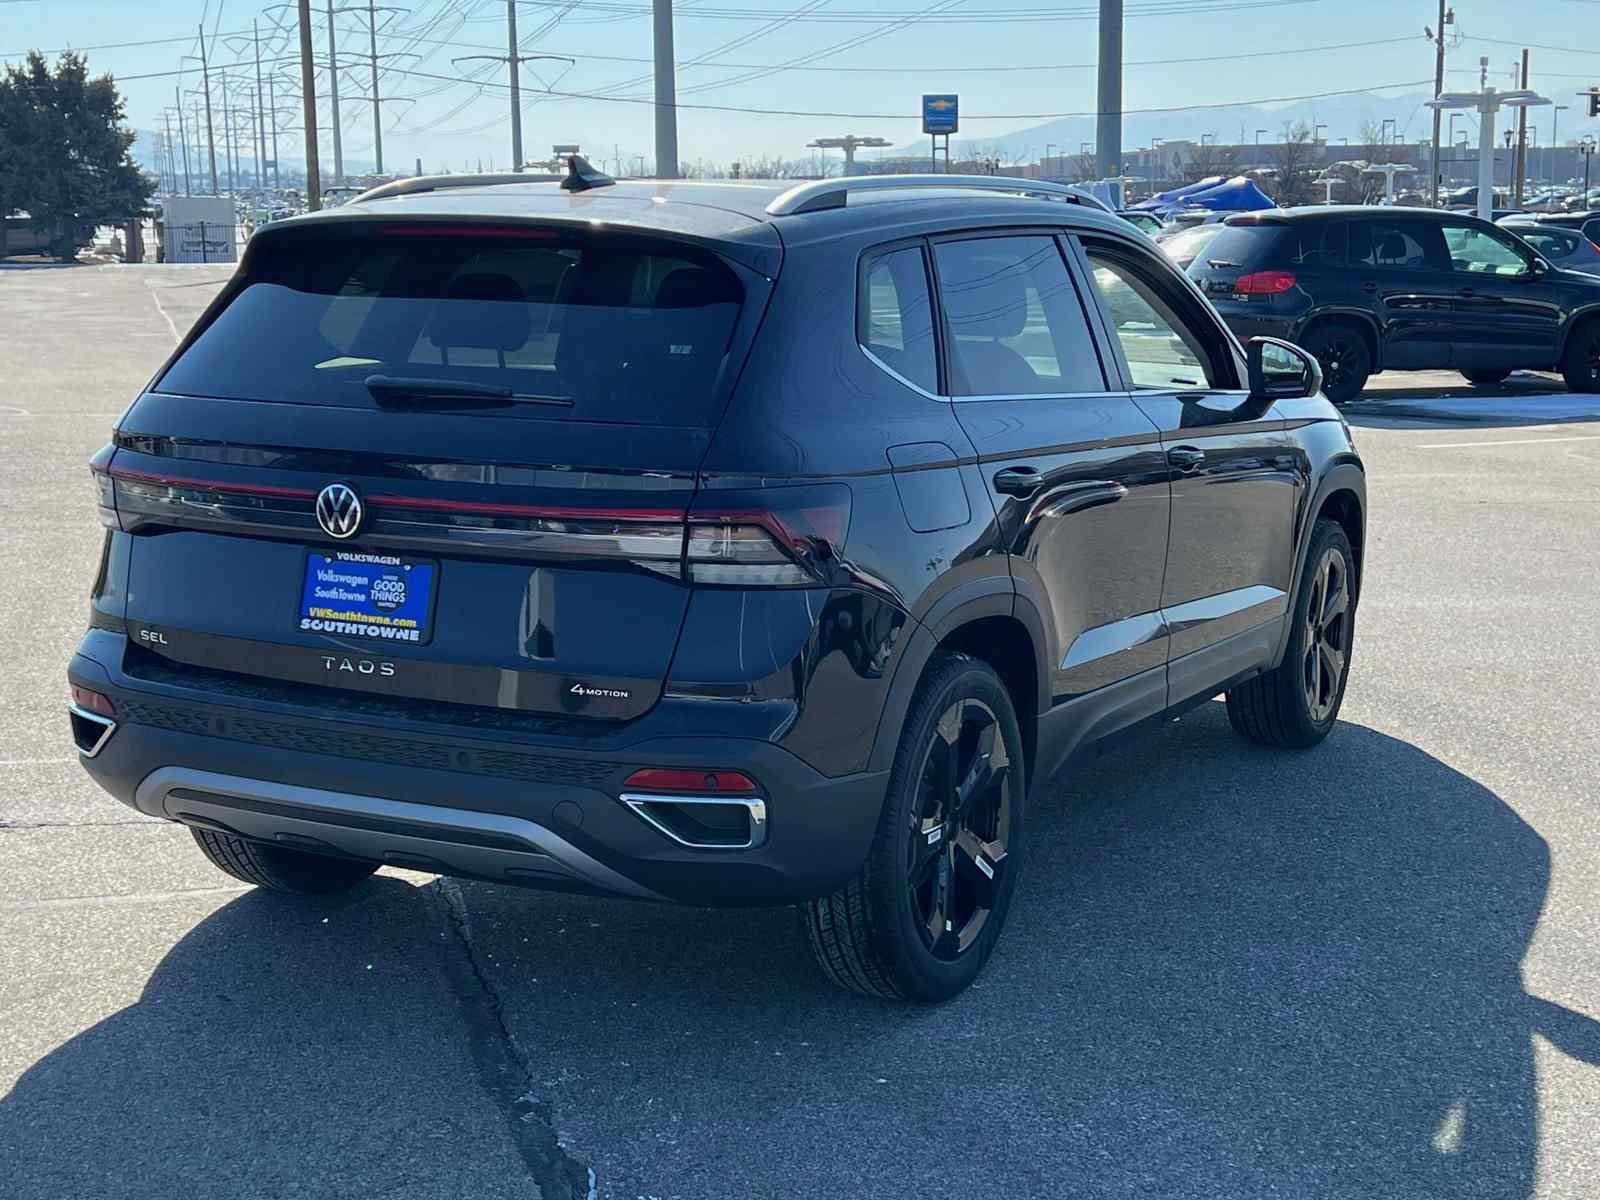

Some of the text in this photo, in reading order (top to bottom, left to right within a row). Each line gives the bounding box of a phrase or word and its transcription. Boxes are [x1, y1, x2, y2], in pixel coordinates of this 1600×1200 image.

[337, 552, 400, 565] VOLKSWAGEN
[316, 569, 369, 587] Volkswagen
[374, 580, 405, 592] GOOD
[370, 590, 406, 603] THINGS
[309, 607, 416, 628] VWSouthtowne.com
[300, 618, 420, 641] SOUTHTOWNE
[140, 630, 168, 644] SEL
[321, 655, 395, 677] TAOS
[570, 684, 629, 698] 4MOTION
